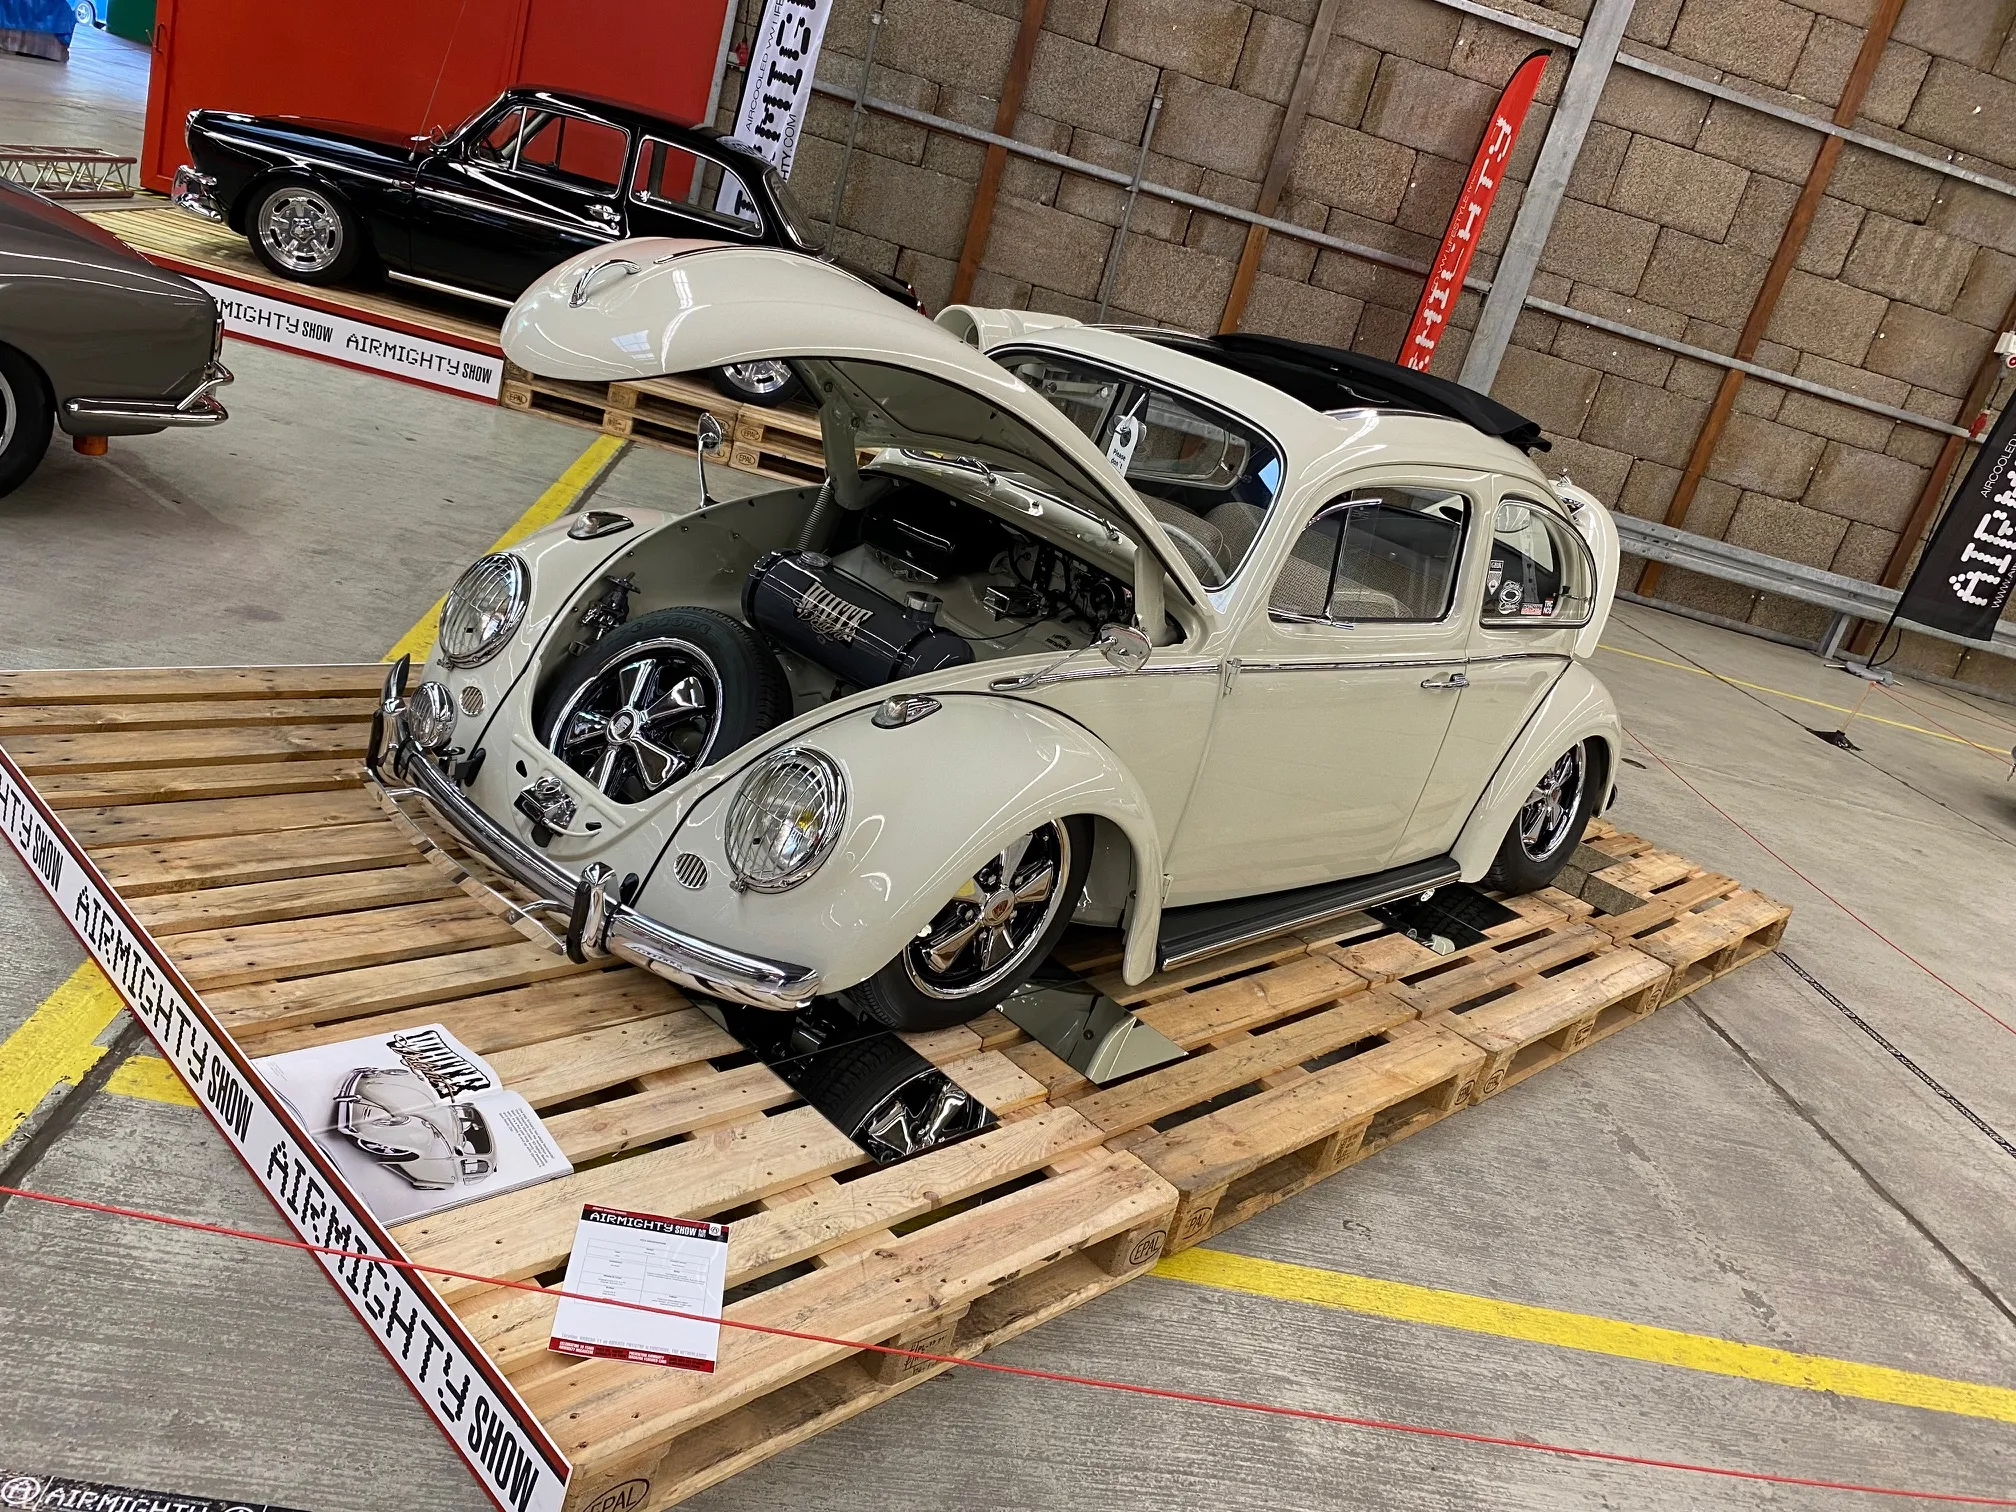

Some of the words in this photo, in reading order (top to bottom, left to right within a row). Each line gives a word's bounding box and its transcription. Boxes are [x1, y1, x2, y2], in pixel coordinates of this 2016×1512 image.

[213, 296, 300, 334] MIGHTY
[301, 321, 333, 343] SHOW
[346, 333, 460, 375] AIRMIGHTY
[462, 362, 493, 384] SHOW
[1981, 438, 2016, 498] AIRCOOLED
[32, 823, 64, 893] SHOW
[75, 885, 209, 1083] AIRMIGHTY
[207, 1054, 254, 1144] SHOW
[589, 1212, 674, 1233] AIRMIGHTY
[674, 1225, 698, 1237] SHOW
[1133, 1235, 1160, 1261] EPAL
[267, 1140, 471, 1422] AIRMIGHTY
[468, 1395, 540, 1512] SHOW
